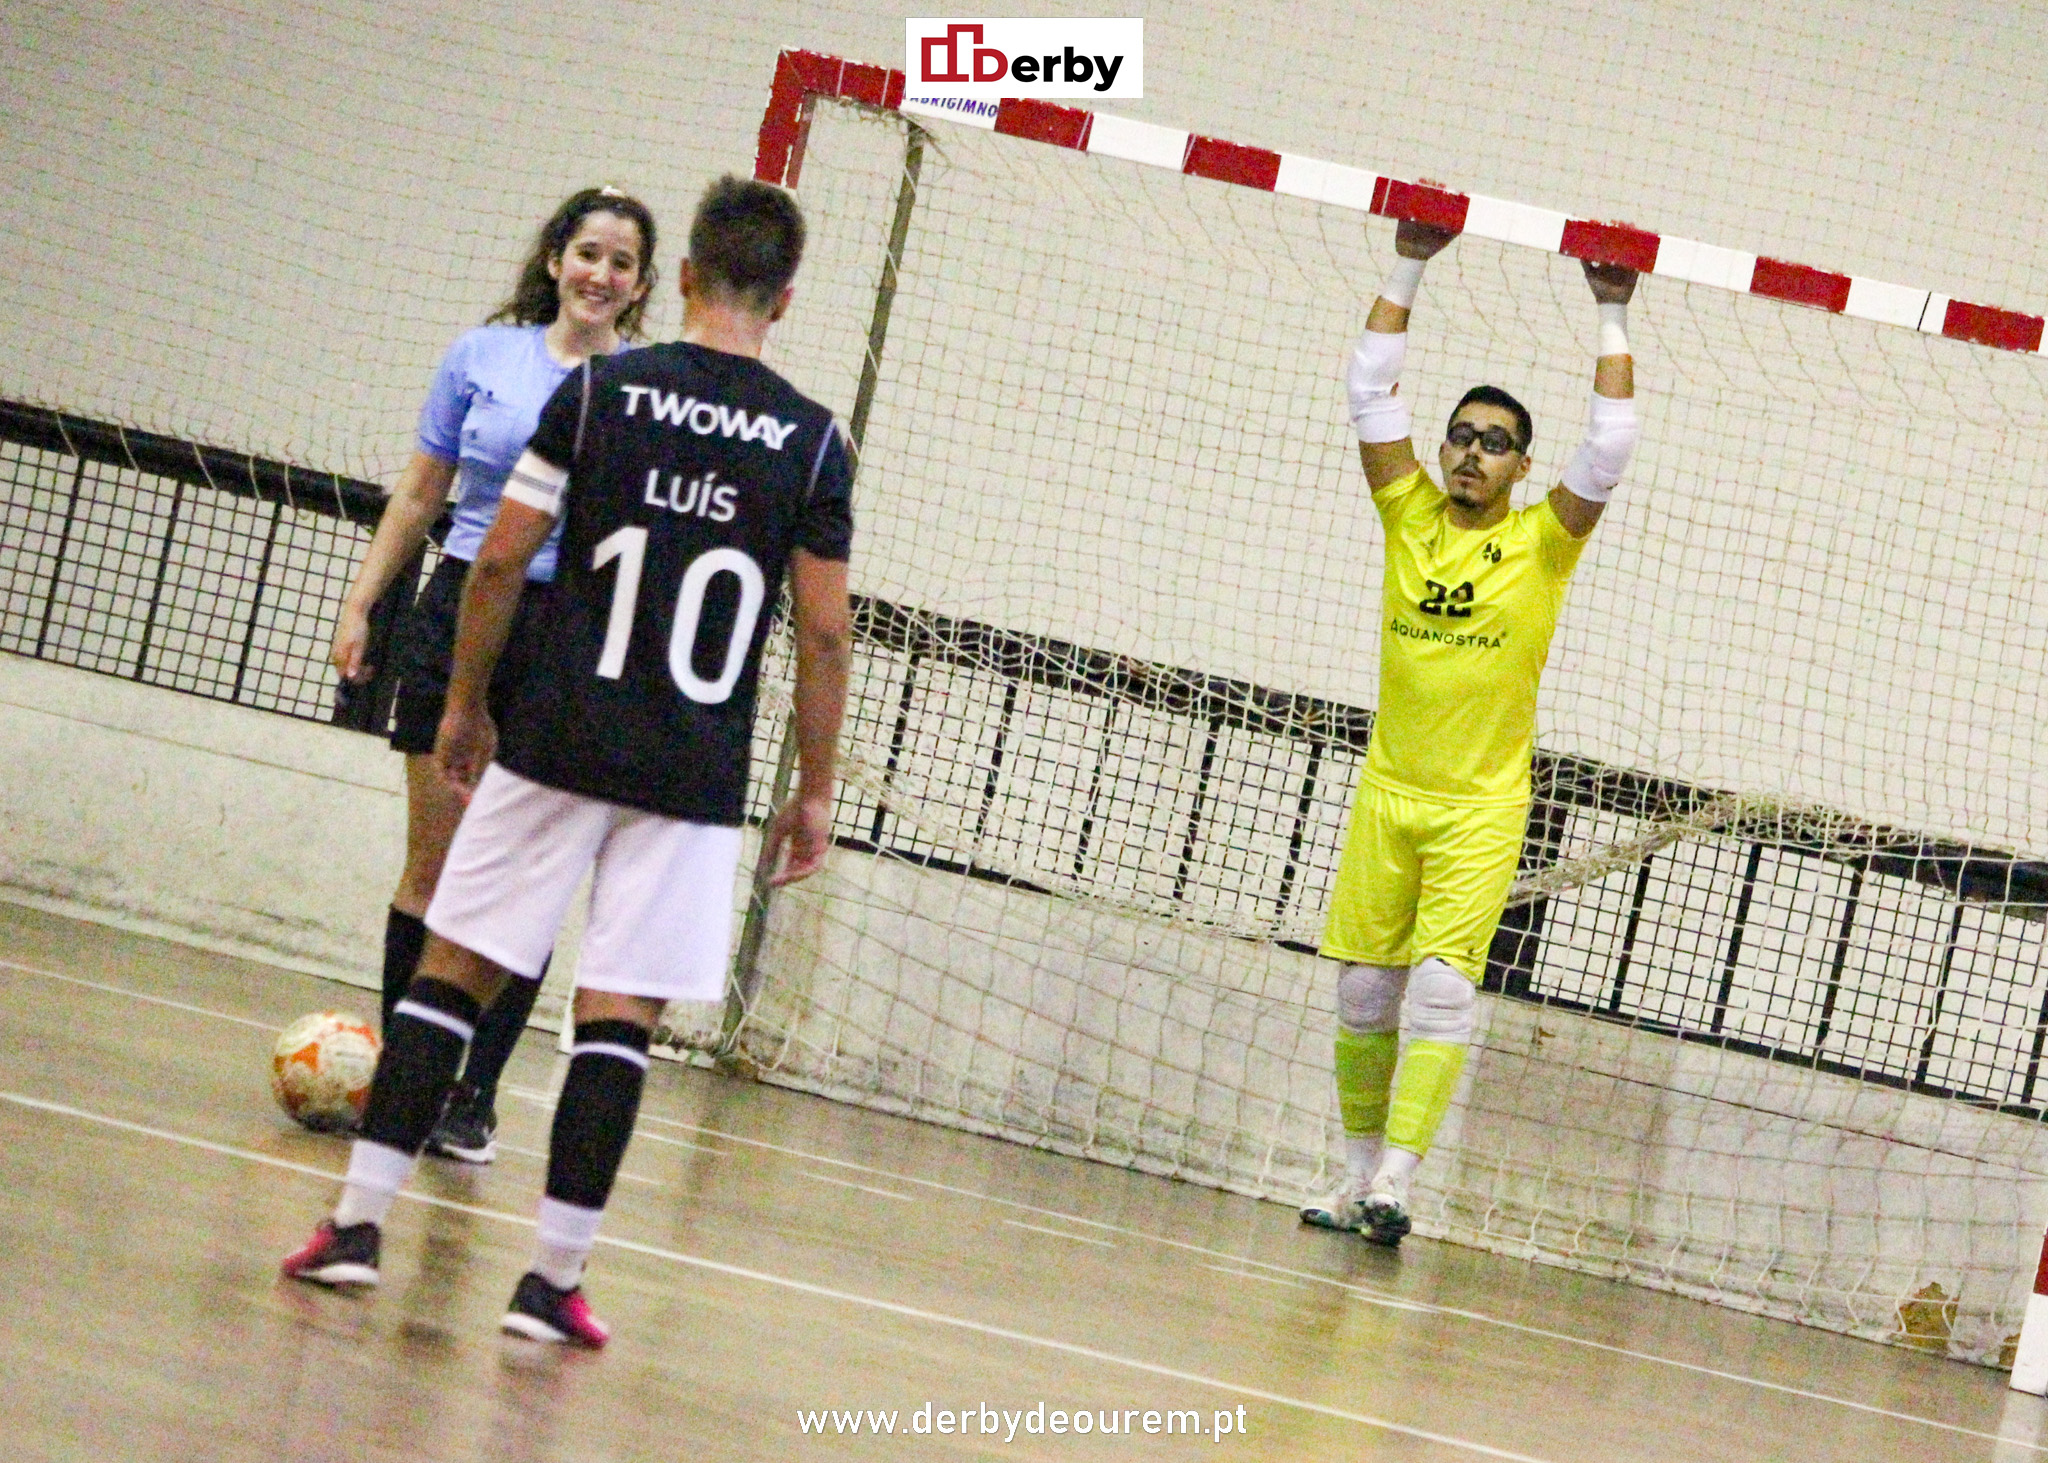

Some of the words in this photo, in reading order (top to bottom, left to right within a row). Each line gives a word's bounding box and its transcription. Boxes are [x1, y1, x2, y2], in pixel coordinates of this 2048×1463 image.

[621, 385, 798, 450] TWOWAY
[645, 469, 739, 522] LUÍS
[592, 526, 766, 705] 10
[1390, 617, 1503, 649] AQUANOSTRA
